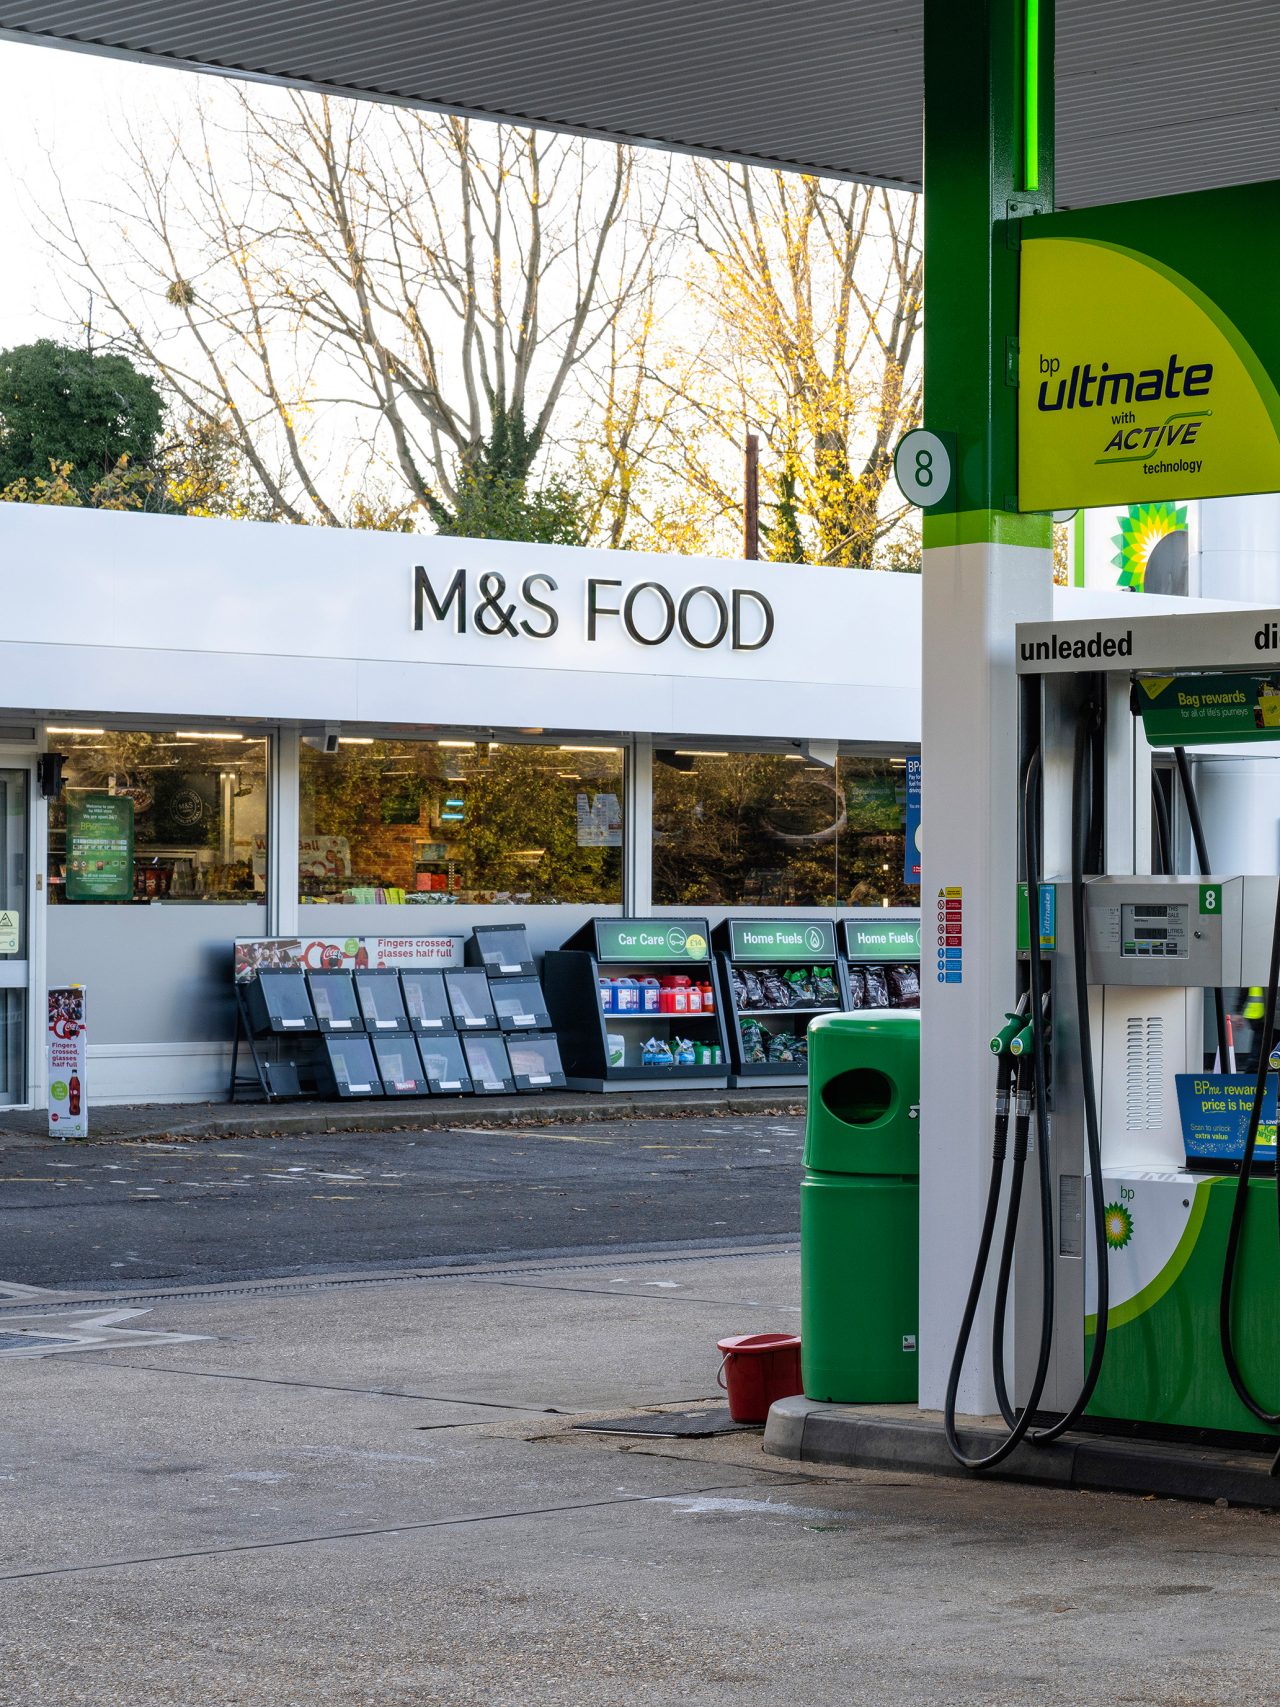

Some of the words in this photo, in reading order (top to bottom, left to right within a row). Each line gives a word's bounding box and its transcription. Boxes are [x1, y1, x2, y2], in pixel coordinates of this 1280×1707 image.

[1040, 355, 1060, 377] bp
[1038, 354, 1213, 412] ultimate
[1111, 411, 1136, 425] with
[1104, 422, 1202, 452] ACTIVE
[915, 449, 933, 487] 8
[1143, 458, 1203, 475] technology
[414, 565, 560, 638] M&S
[587, 578, 775, 650] FOOD
[1020, 631, 1133, 661] unleaded
[1177, 692, 1200, 707] Bag
[1201, 690, 1246, 704] rewards
[1181, 709, 1190, 718] for
[1191, 708, 1199, 717] all
[1200, 708, 1206, 717] of
[1222, 707, 1248, 718] journeys
[908, 761, 920, 773] BP
[1205, 890, 1216, 909] 8
[377, 939, 413, 949] Fingers
[415, 939, 455, 949] crossed,
[618, 933, 638, 946] Car
[639, 933, 664, 946] Care
[743, 933, 774, 945] Home
[776, 932, 802, 944] Fuels
[857, 932, 886, 944] Home
[888, 932, 914, 944] Fuels
[377, 949, 413, 959] glasses
[415, 948, 434, 958] half
[436, 948, 452, 958] full
[51, 1042, 77, 1050] Fingers
[1201, 1099, 1226, 1112] price
[1228, 1099, 1237, 1110] is
[1239, 1099, 1255, 1111] he
[1120, 1184, 1135, 1201] bp
